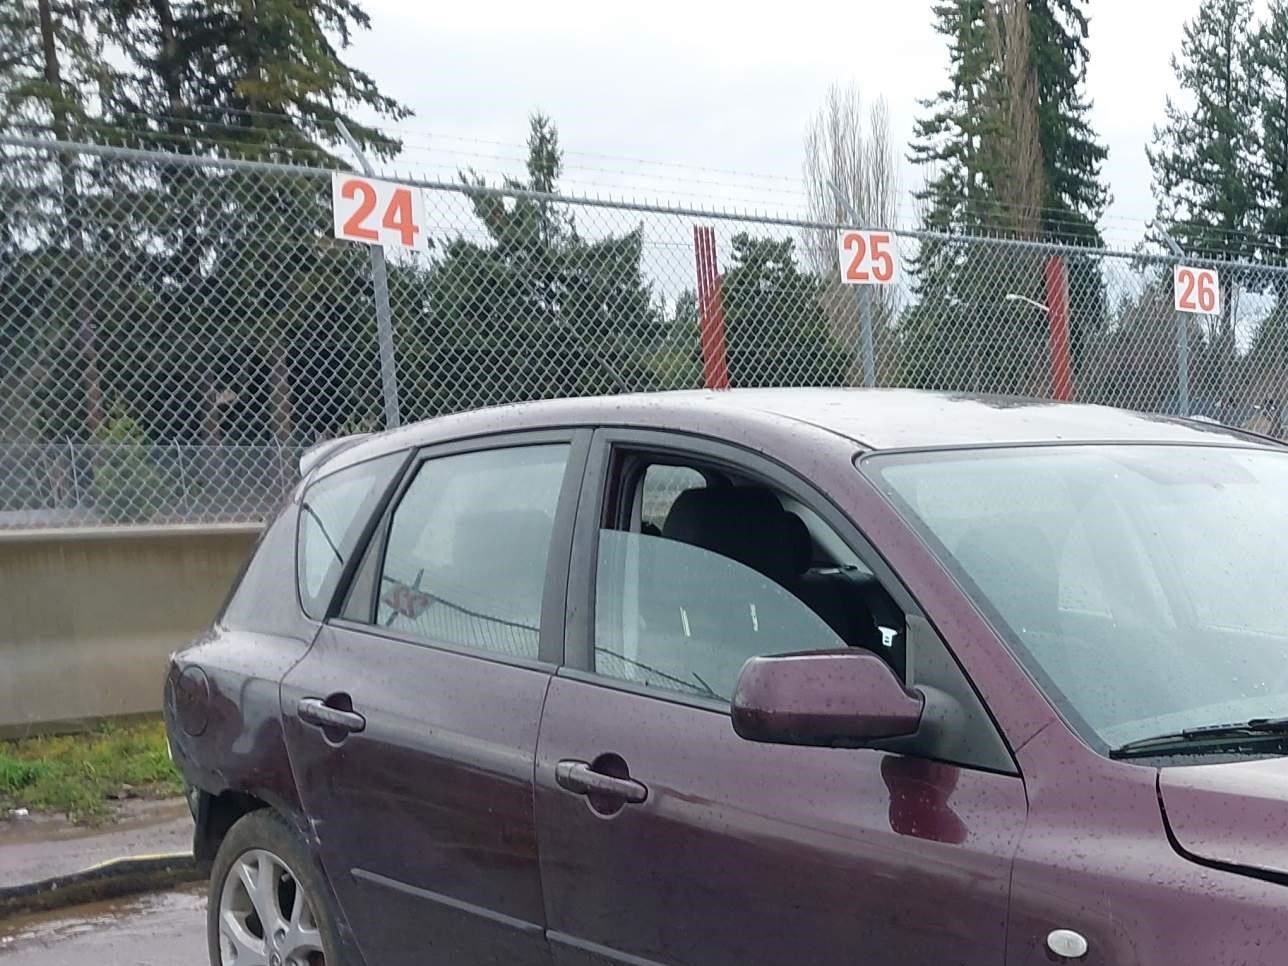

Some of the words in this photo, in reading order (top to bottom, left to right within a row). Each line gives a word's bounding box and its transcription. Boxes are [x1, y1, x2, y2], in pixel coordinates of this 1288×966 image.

[341, 179, 418, 247] 24
[844, 233, 894, 282] 25
[1178, 270, 1215, 312] 26
